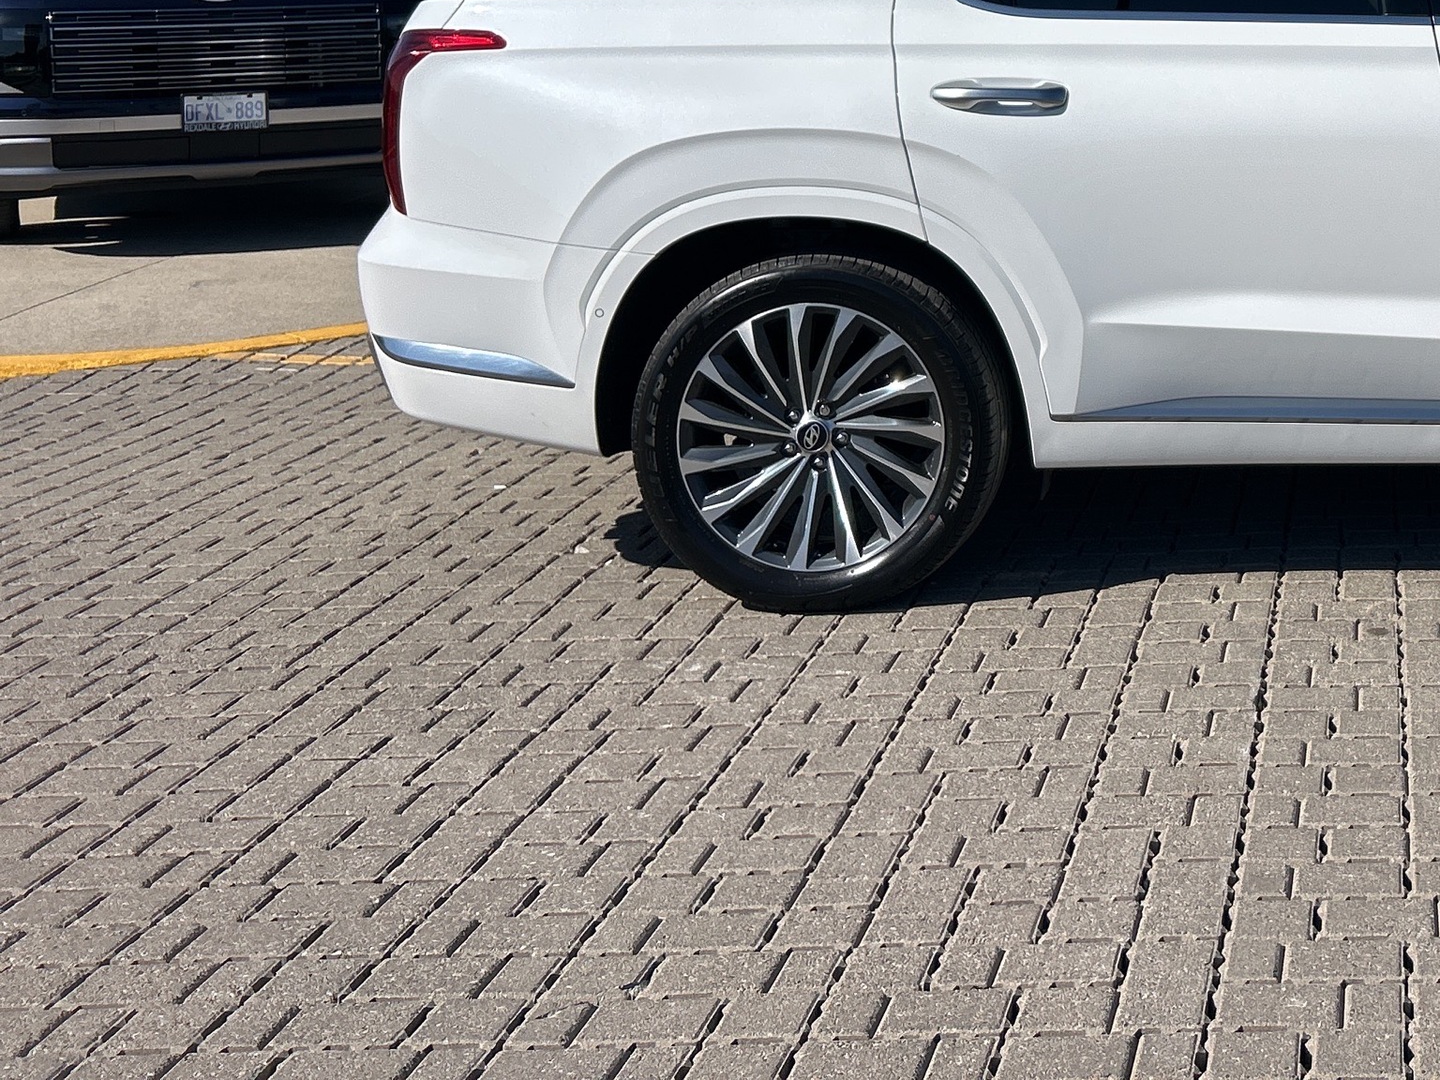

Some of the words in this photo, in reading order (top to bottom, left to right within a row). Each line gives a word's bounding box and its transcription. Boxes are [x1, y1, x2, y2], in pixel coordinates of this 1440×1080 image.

[185, 102, 225, 122] DFXL
[235, 100, 264, 119] 889
[184, 123, 216, 133] REXDALE
